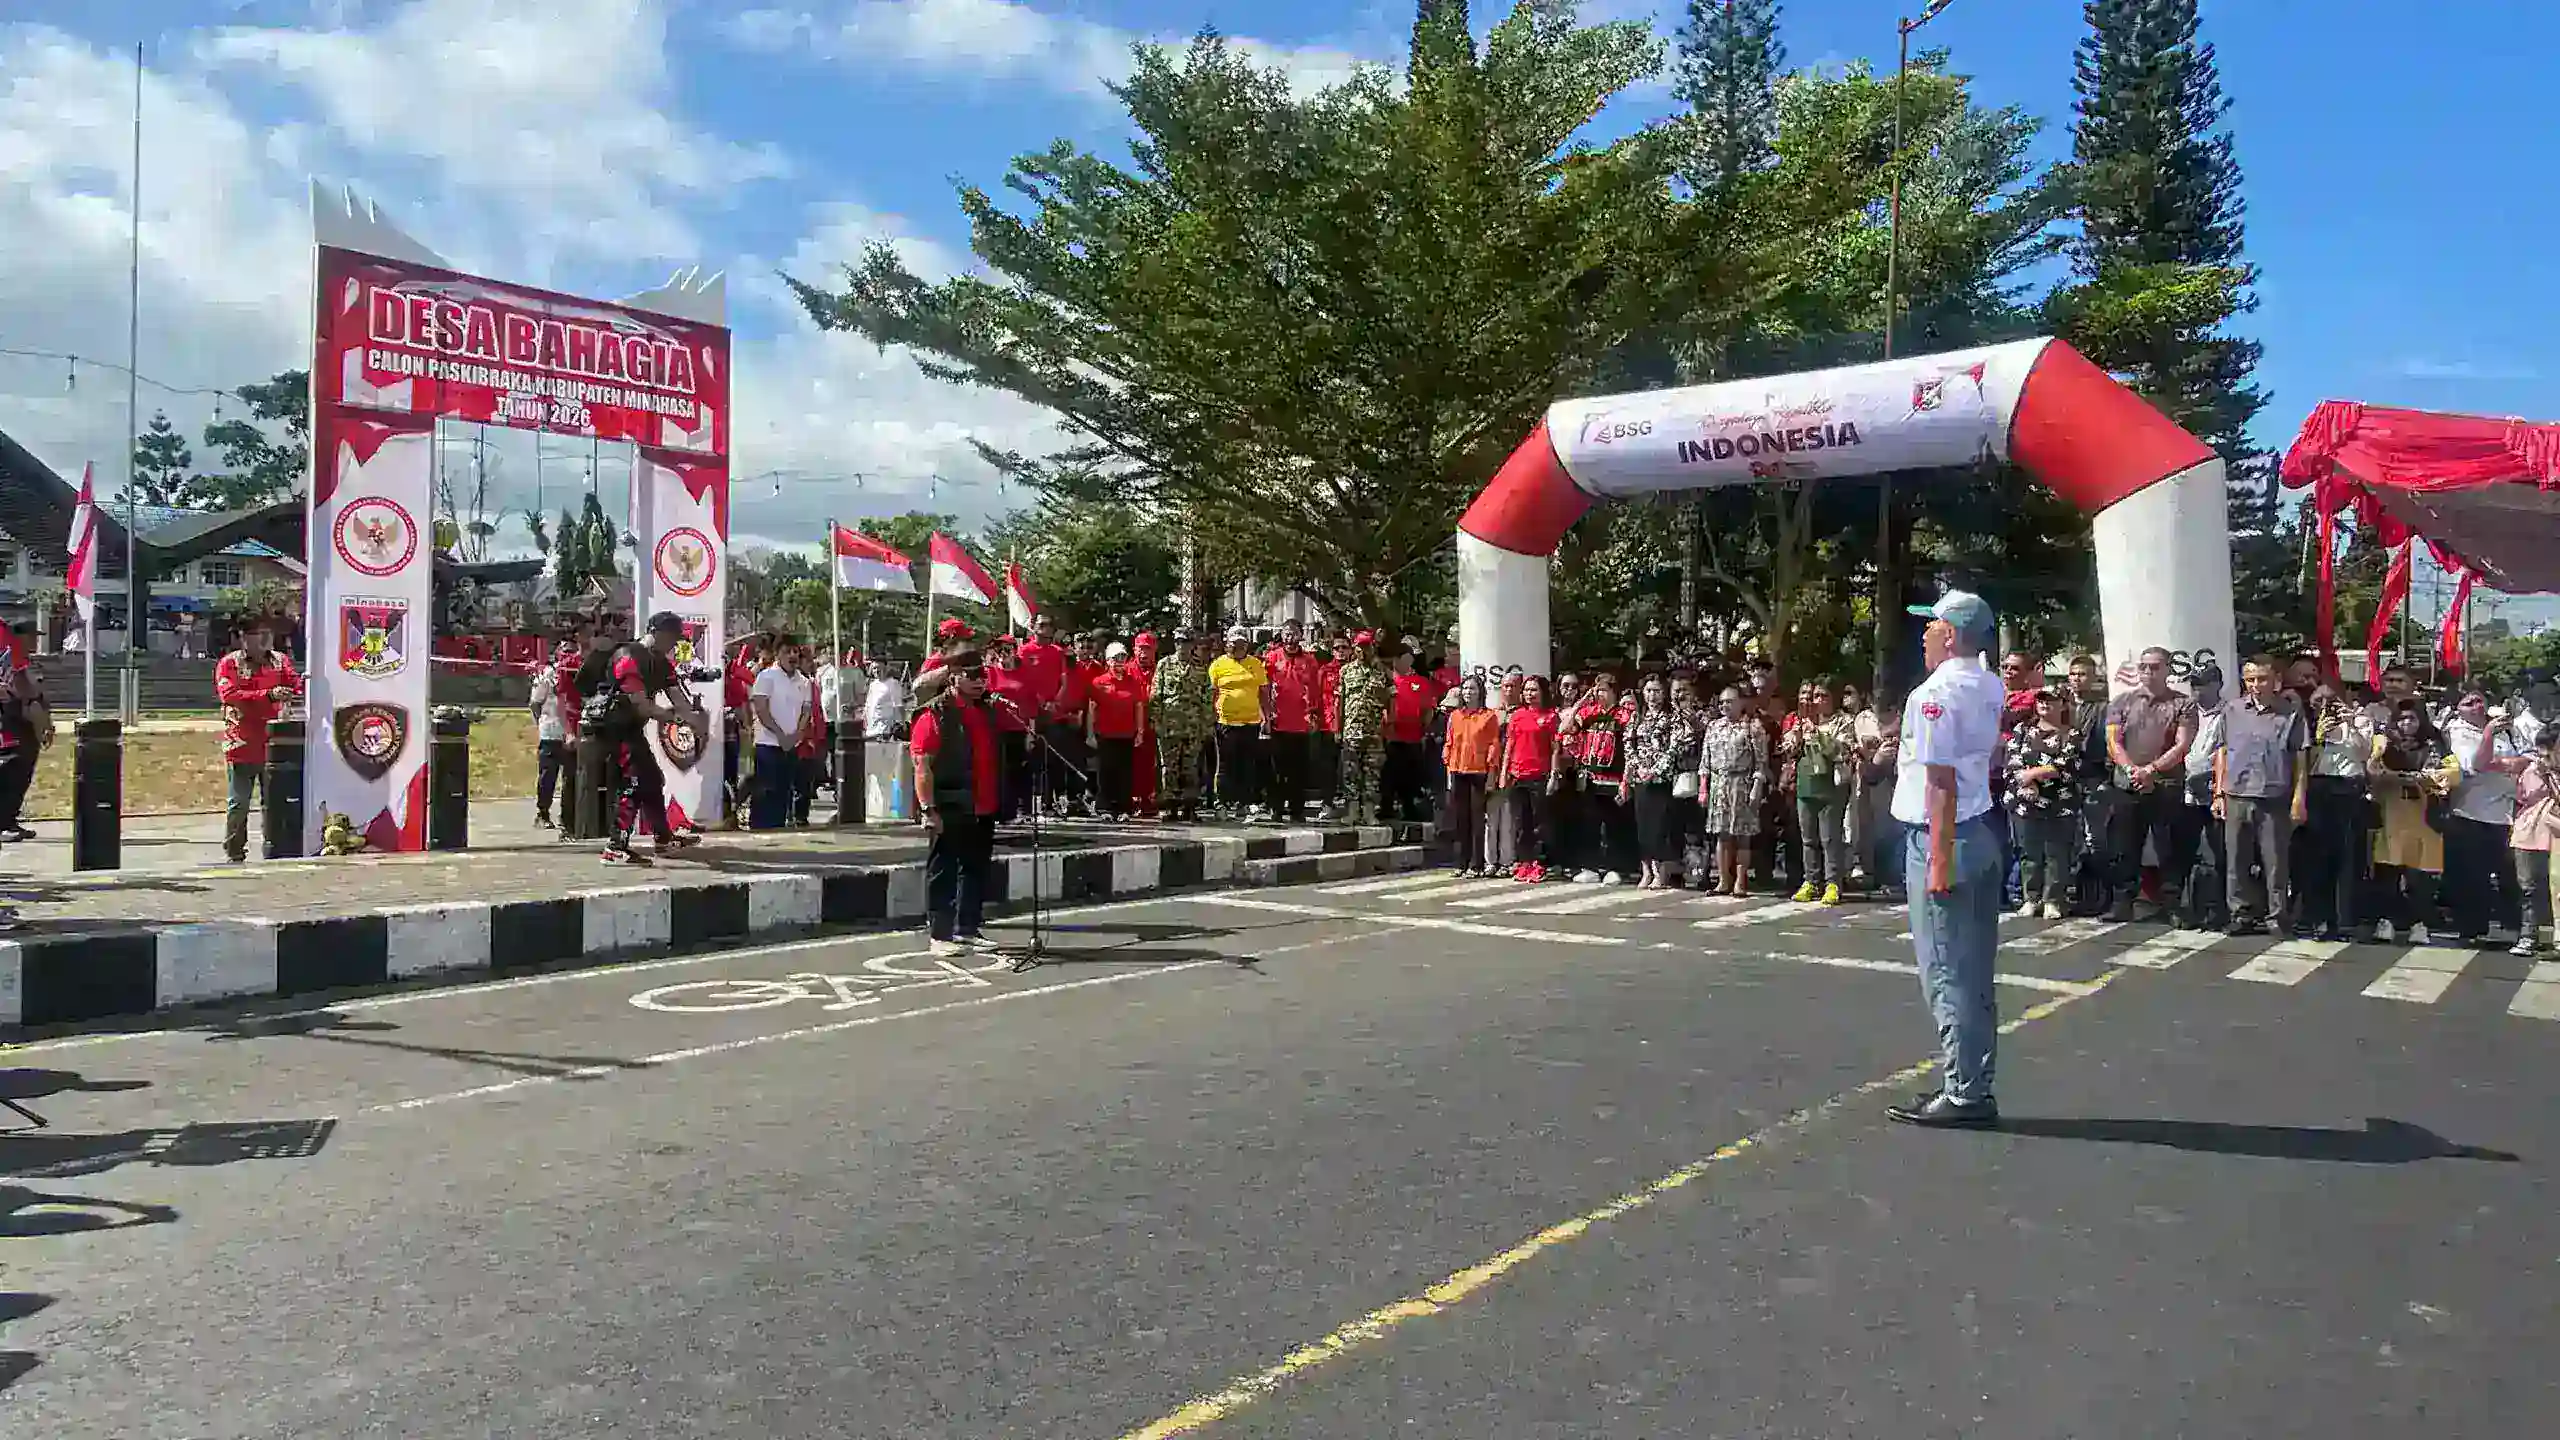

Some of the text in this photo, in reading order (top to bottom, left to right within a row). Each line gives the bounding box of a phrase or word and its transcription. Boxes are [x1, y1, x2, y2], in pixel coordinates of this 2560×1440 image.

[369, 286, 696, 394] DESA BAHAGIA
[368, 349, 696, 418] CALON PASKIBRAKA KABUPATEN MINAHASA
[496, 396, 592, 427] TAHUN 2026
[1614, 420, 1652, 438] BSG
[1677, 421, 1862, 463] INDONESIA
